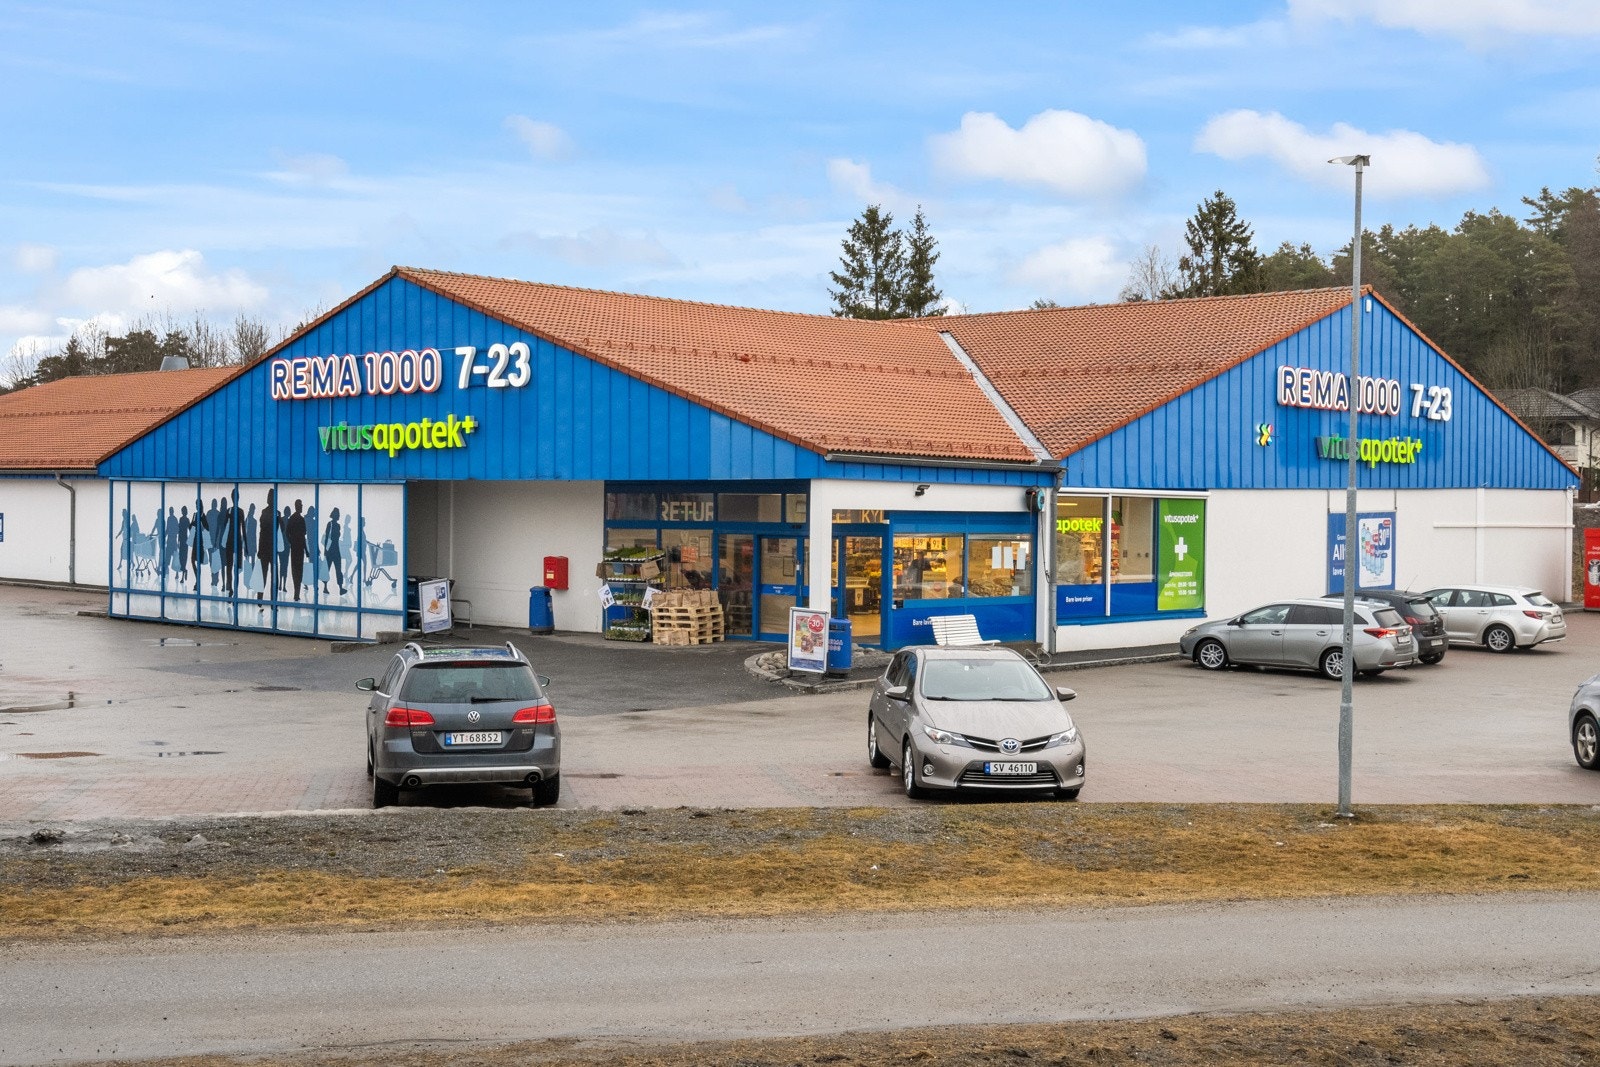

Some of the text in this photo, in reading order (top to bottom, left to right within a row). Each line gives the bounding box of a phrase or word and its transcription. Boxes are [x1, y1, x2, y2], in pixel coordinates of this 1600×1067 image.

[271, 342, 531, 400] REMA 1000 7-23
[1277, 365, 1350, 411] REMA
[1410, 383, 1452, 422] 7-23
[1333, 544, 1346, 560] All
[453, 731, 499, 743] YT 68852
[993, 763, 1033, 772] SV 46110
